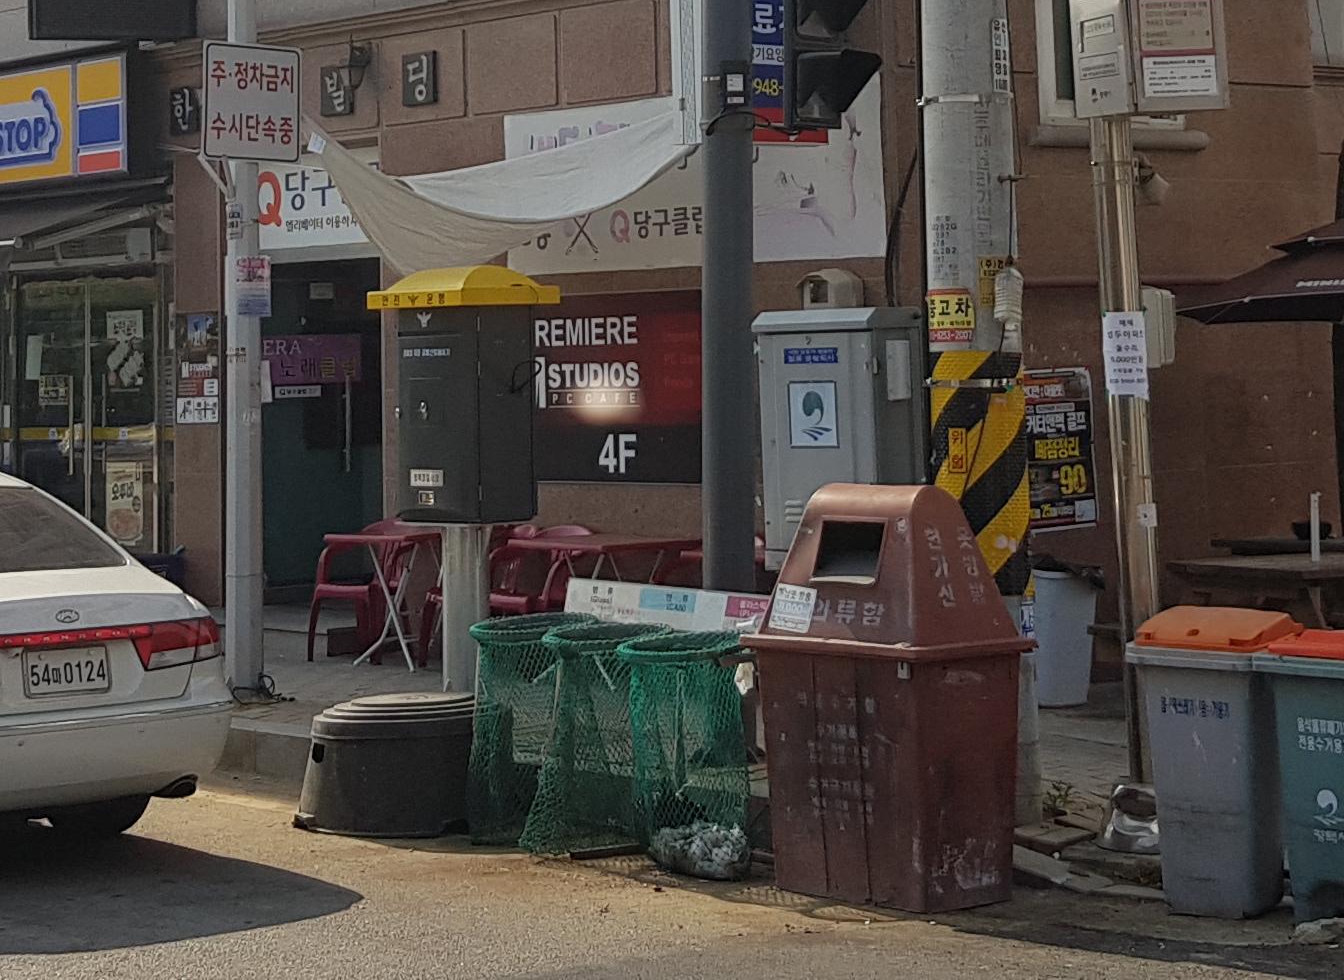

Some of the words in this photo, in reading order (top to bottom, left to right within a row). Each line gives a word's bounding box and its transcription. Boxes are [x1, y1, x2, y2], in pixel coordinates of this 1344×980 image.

[211, 60, 296, 95] 주·정차금지
[210, 115, 294, 145] 수시단속중
[258, 171, 282, 227] Q
[285, 170, 346, 211] 당구
[610, 208, 631, 244] Q
[929, 297, 972, 319] 중고차
[534, 316, 639, 347] REMIERE
[262, 339, 302, 356] ERA
[548, 362, 640, 388] STUDIOS
[585, 392, 637, 404] CAFE
[598, 433, 638, 474] 4F
[1059, 463, 1088, 496] 90
[30, 658, 106, 687] 54마0124
